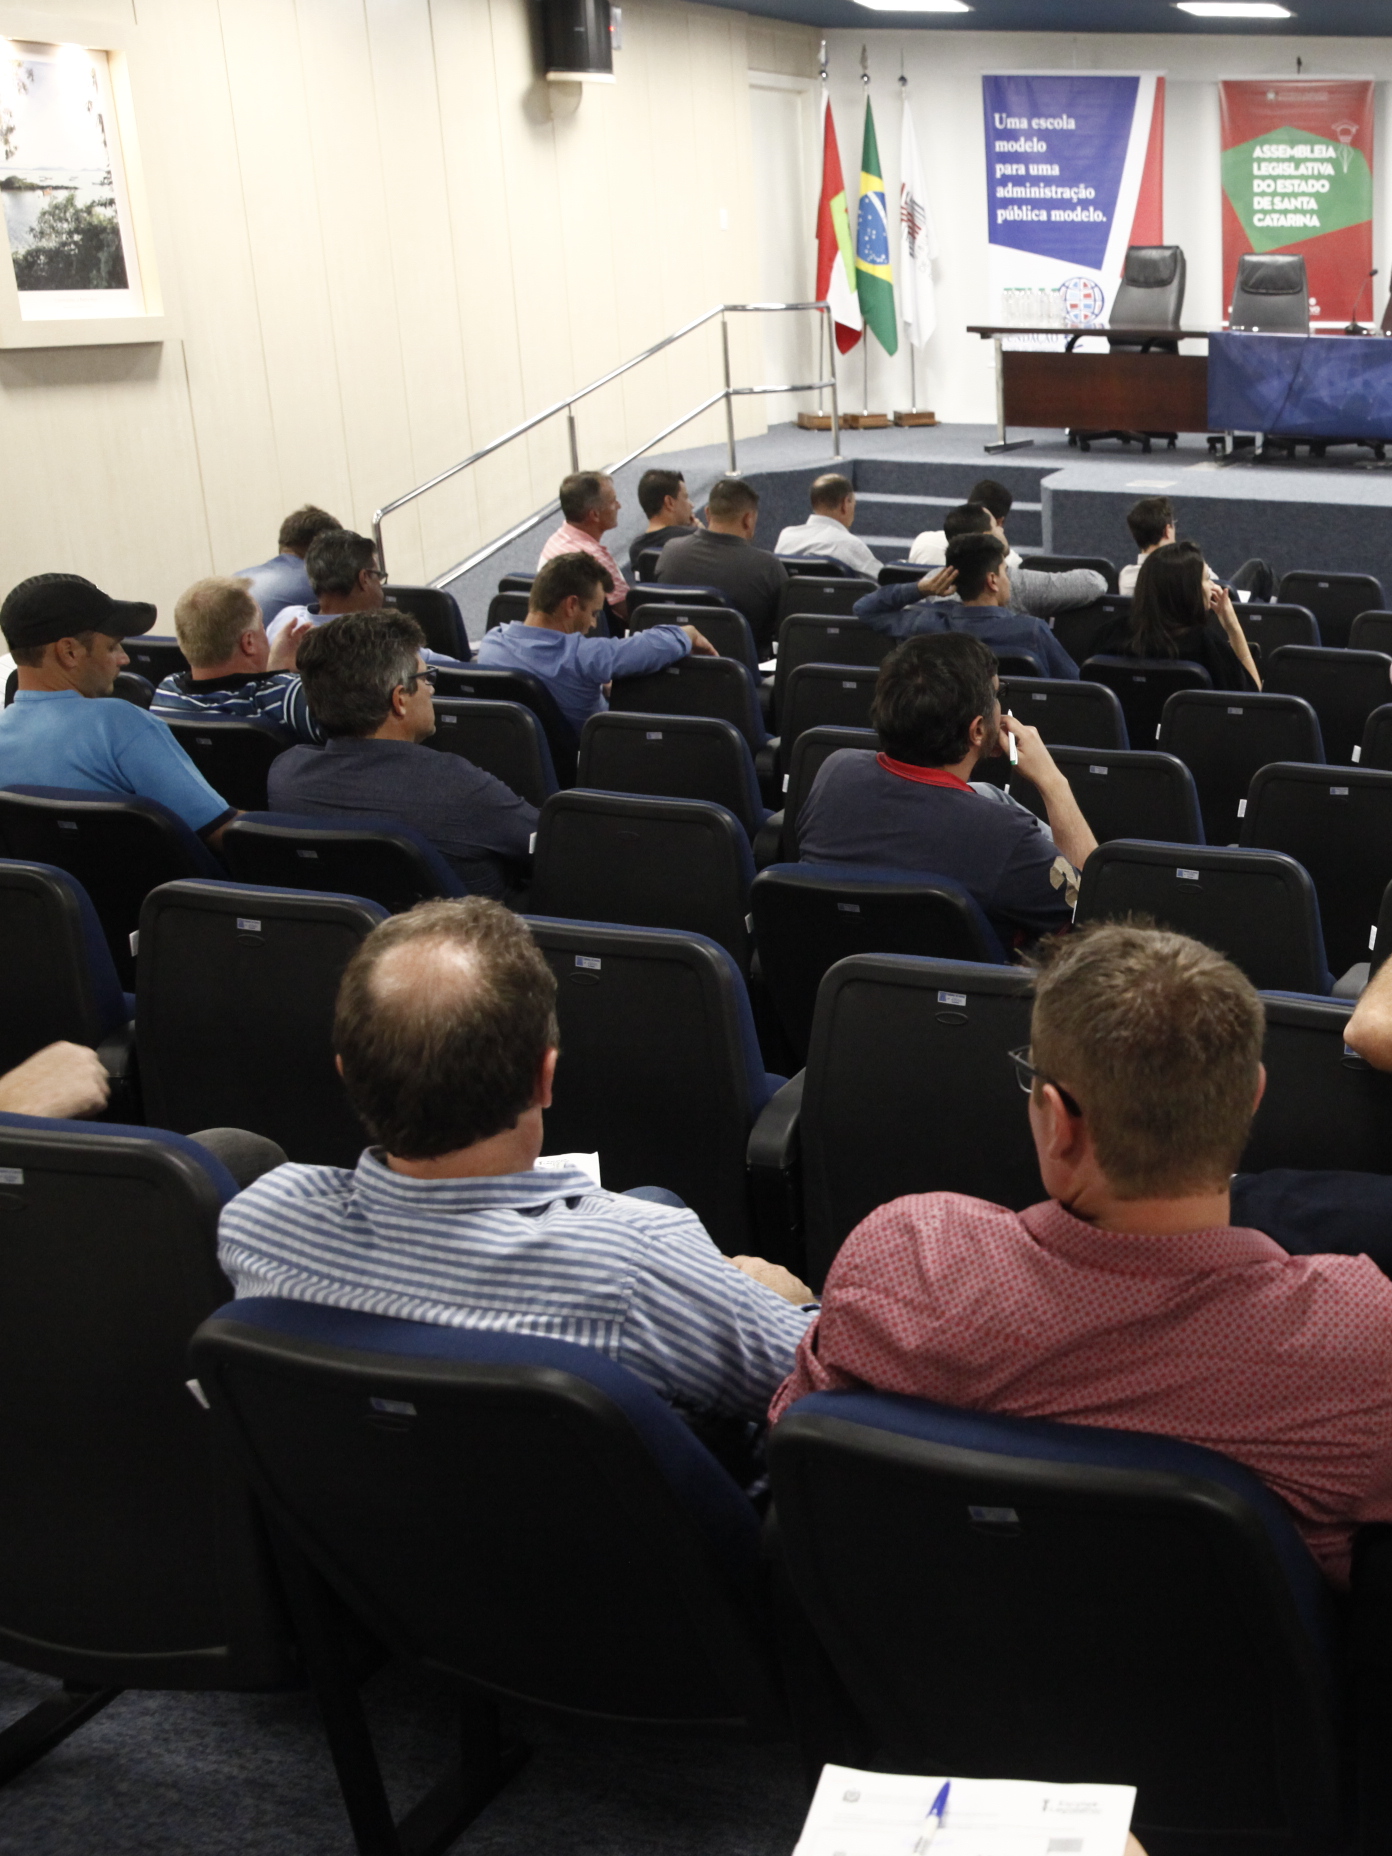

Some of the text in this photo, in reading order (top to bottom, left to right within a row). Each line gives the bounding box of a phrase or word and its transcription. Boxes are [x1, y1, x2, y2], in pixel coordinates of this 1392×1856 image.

[994, 113, 1075, 129] Uma escola
[995, 137, 1047, 152] modelo
[1253, 144, 1336, 158] ASSEMBLEIA
[995, 163, 1060, 178] para uma
[1253, 162, 1335, 176] LEGISLATIVA
[996, 182, 1095, 203] administração
[1253, 179, 1330, 193] DO ESTADO
[1253, 196, 1318, 210] DE SANTA
[997, 205, 1107, 224] pública modelo.
[1253, 213, 1321, 227] CATARINA
